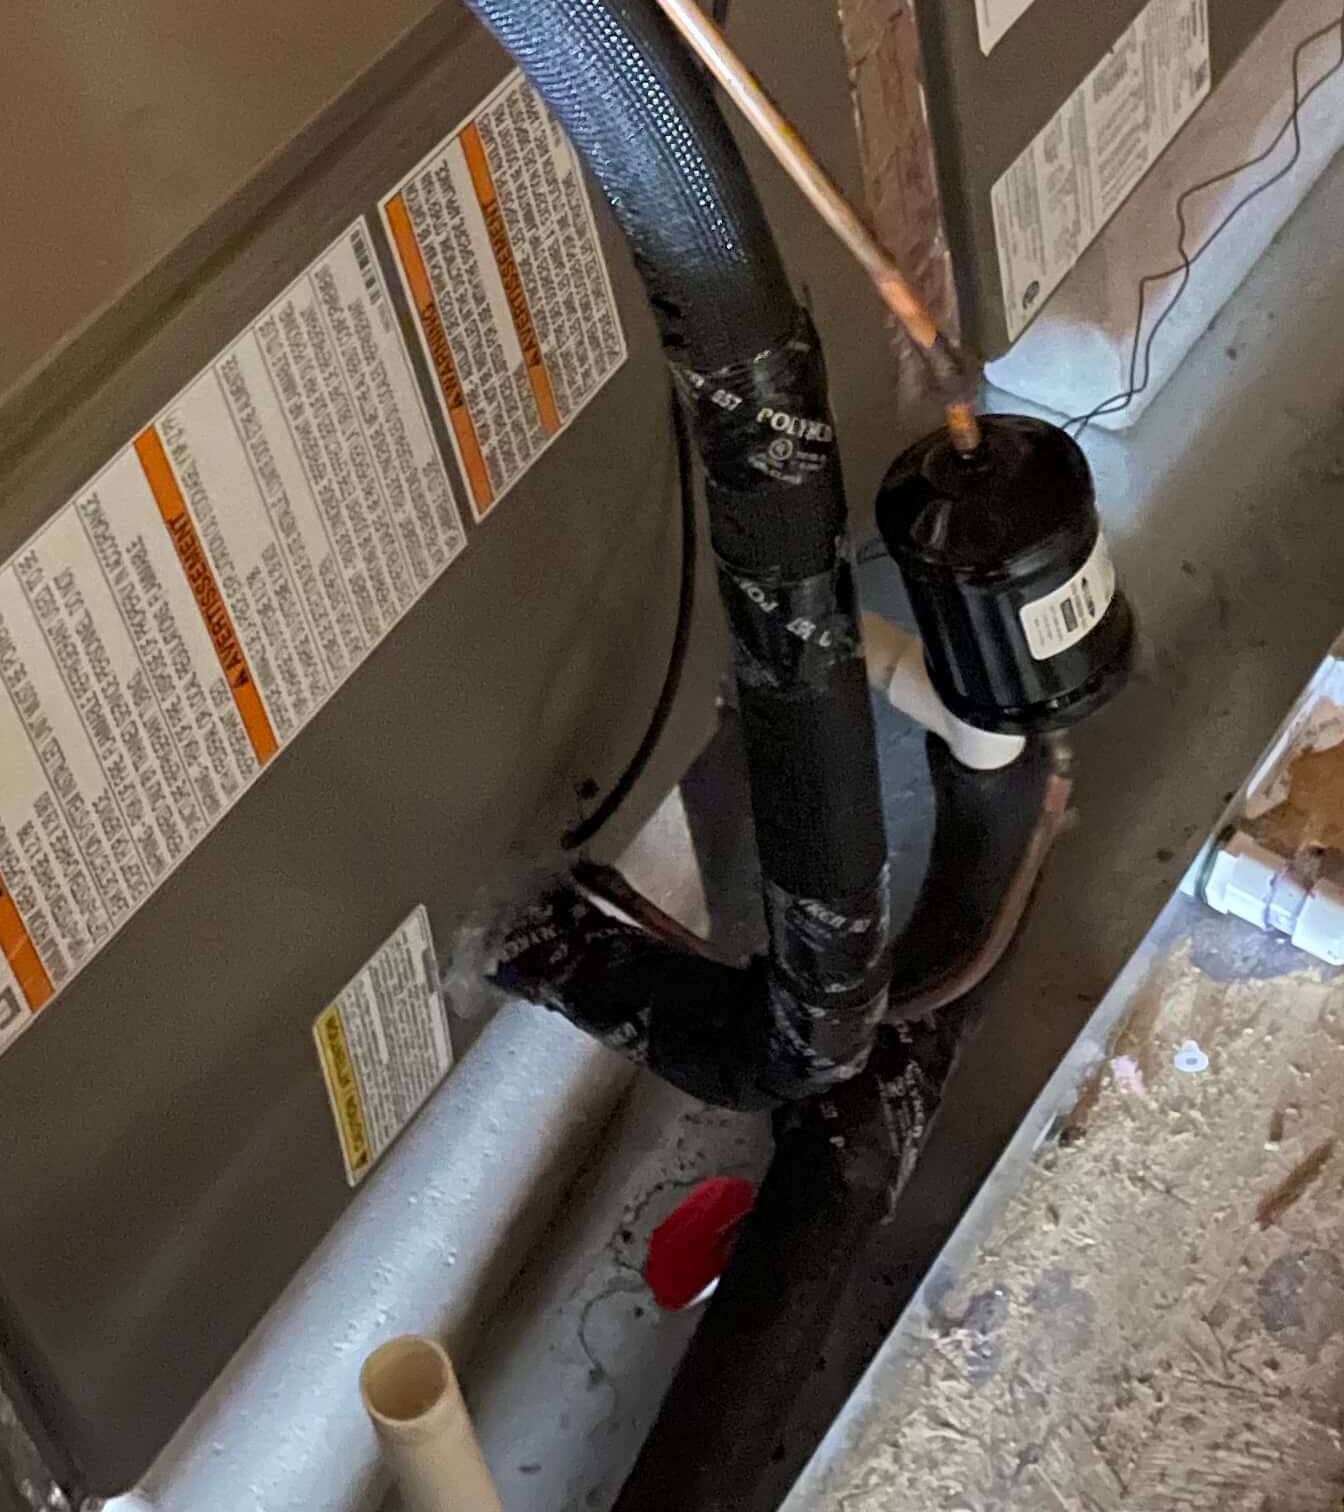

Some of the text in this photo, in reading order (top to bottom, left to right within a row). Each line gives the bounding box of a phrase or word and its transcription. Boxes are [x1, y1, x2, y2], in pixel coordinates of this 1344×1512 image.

[420, 301, 460, 397] WARNING
[484, 199, 537, 356] AVERTISSEMENT
[167, 510, 243, 673] AVERTISSEMENT
